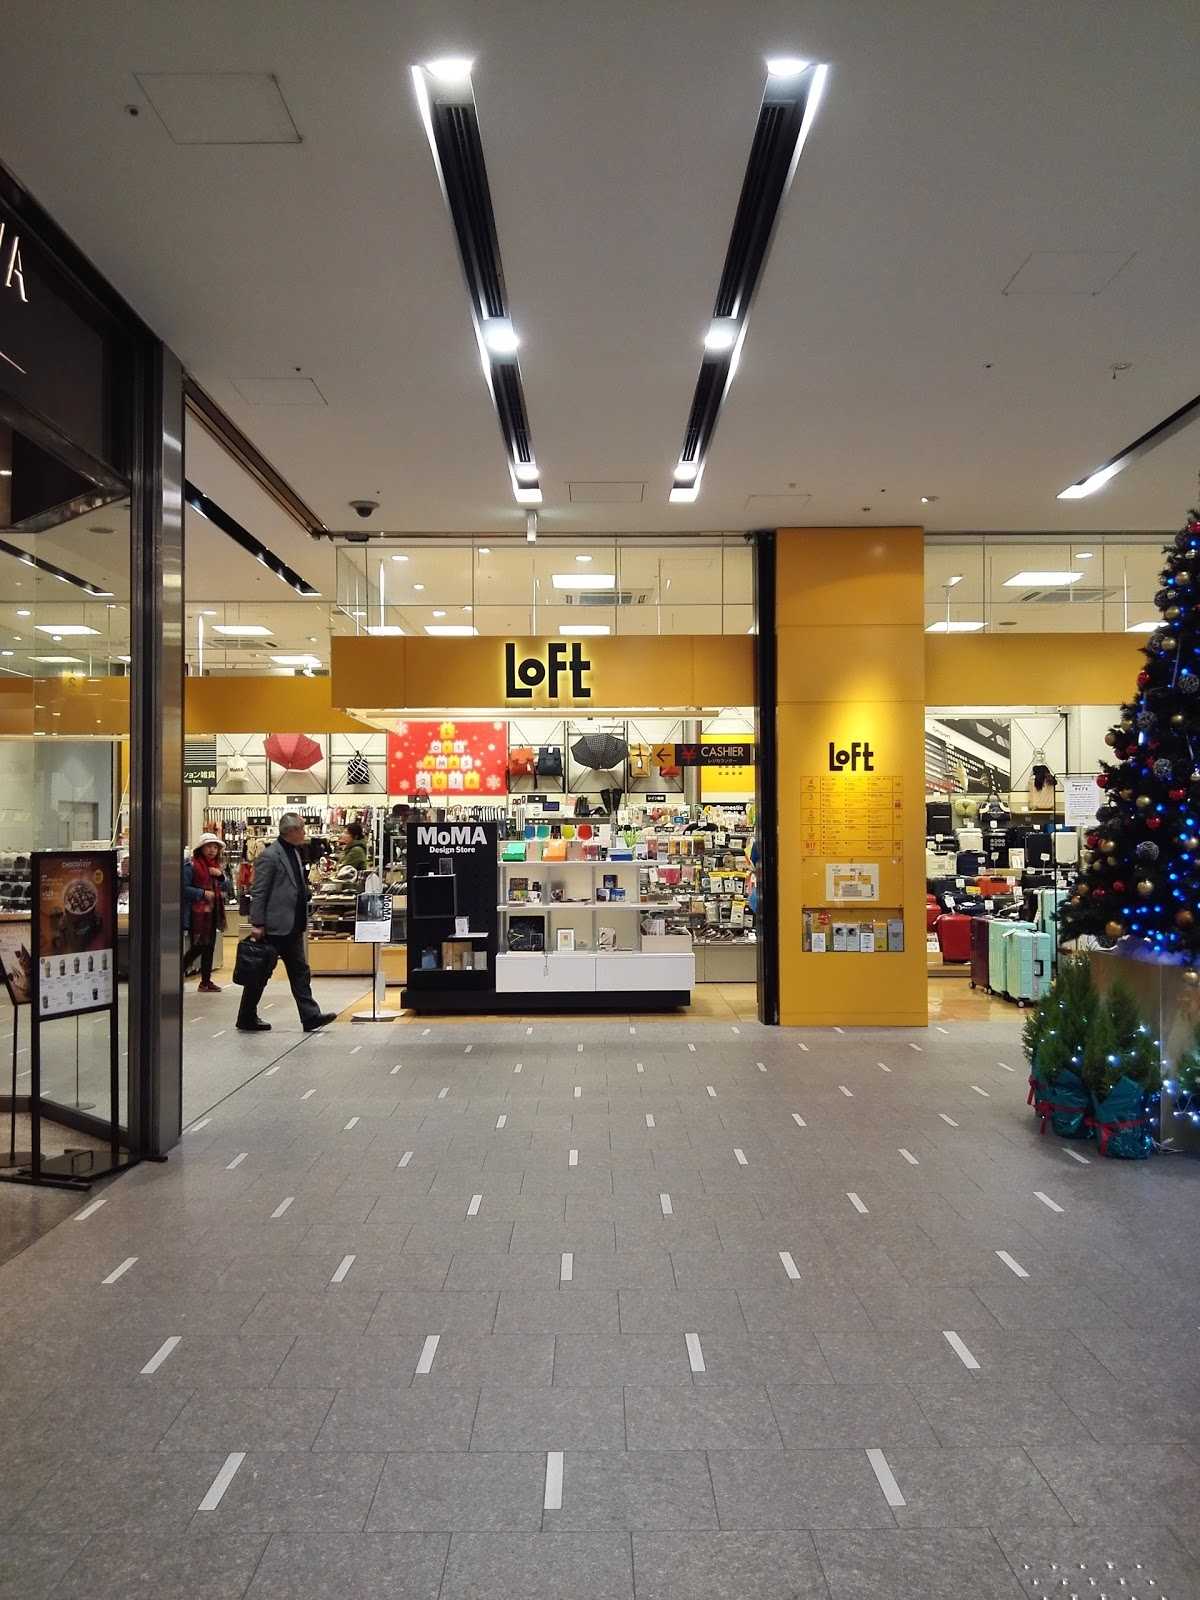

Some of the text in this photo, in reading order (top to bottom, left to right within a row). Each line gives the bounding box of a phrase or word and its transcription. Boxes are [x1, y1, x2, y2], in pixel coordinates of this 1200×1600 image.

[701, 746, 744, 757] CASHIER
[416, 826, 487, 846] MoMA
[429, 846, 476, 855] Design Store
[383, 895, 392, 921] MoMA
